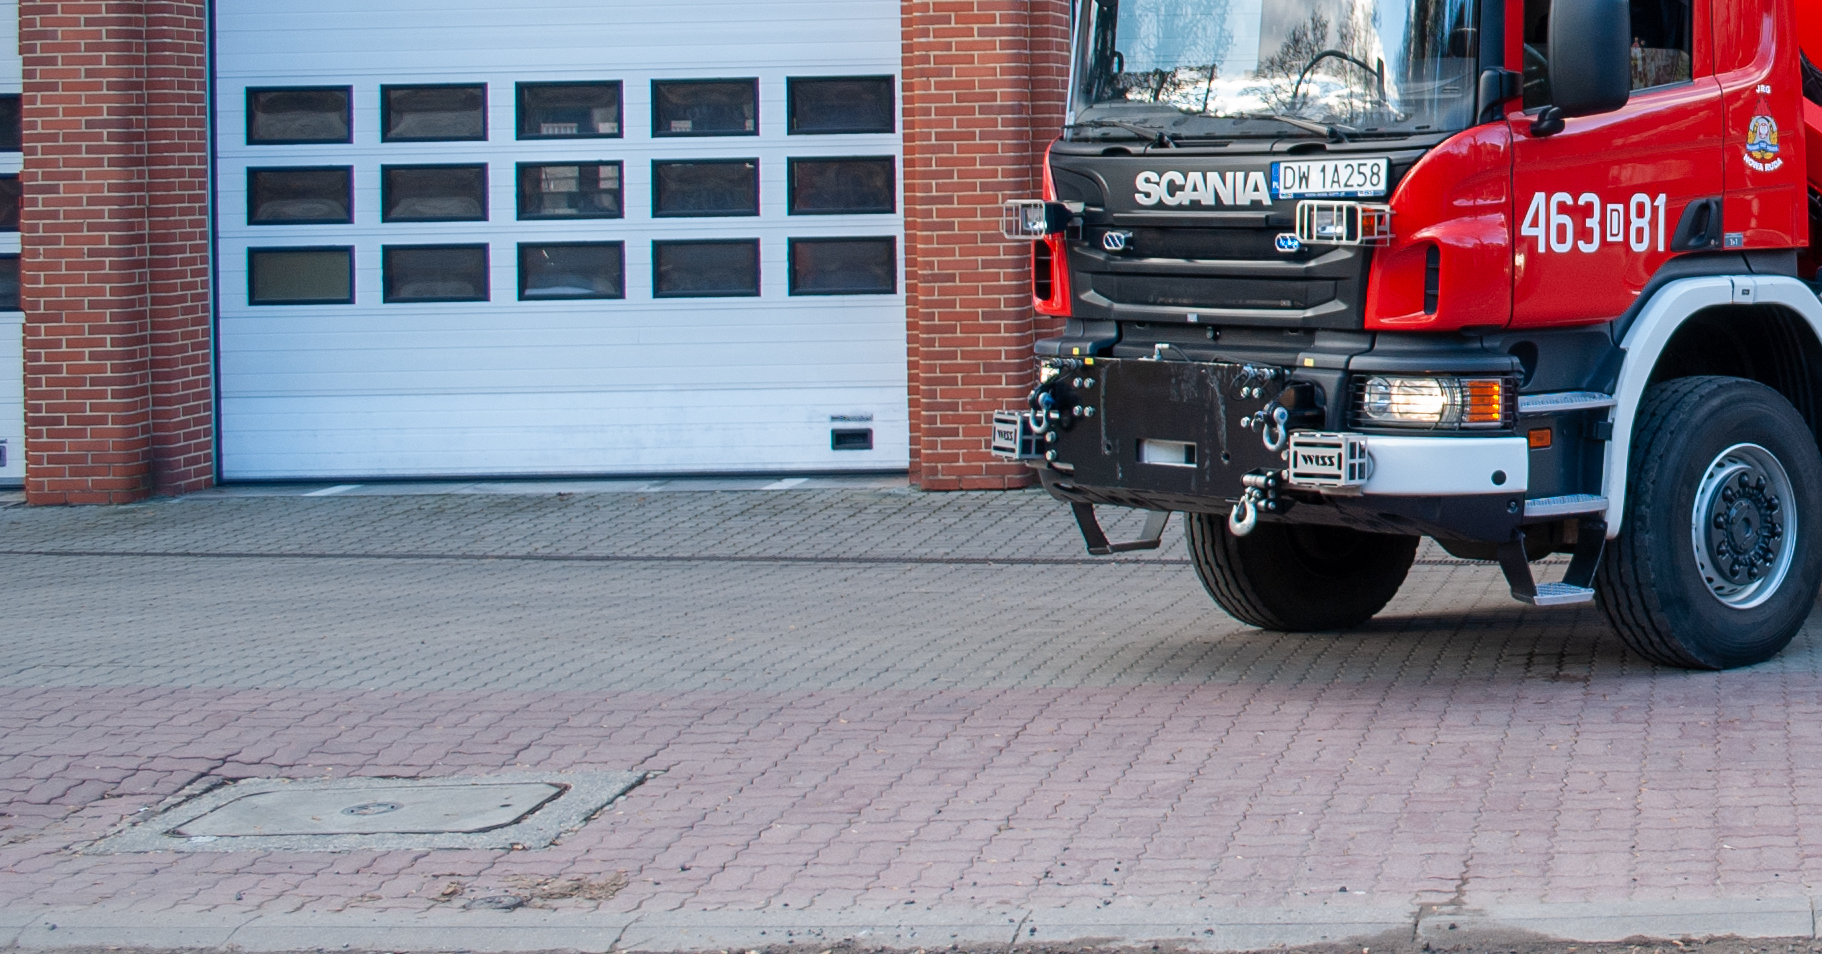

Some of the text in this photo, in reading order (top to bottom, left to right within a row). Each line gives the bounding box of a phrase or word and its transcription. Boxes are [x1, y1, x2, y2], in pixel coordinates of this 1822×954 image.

[1134, 170, 1273, 206] SCANIA
[1283, 162, 1381, 190] DW 1A258
[1300, 453, 1336, 467] WISS
